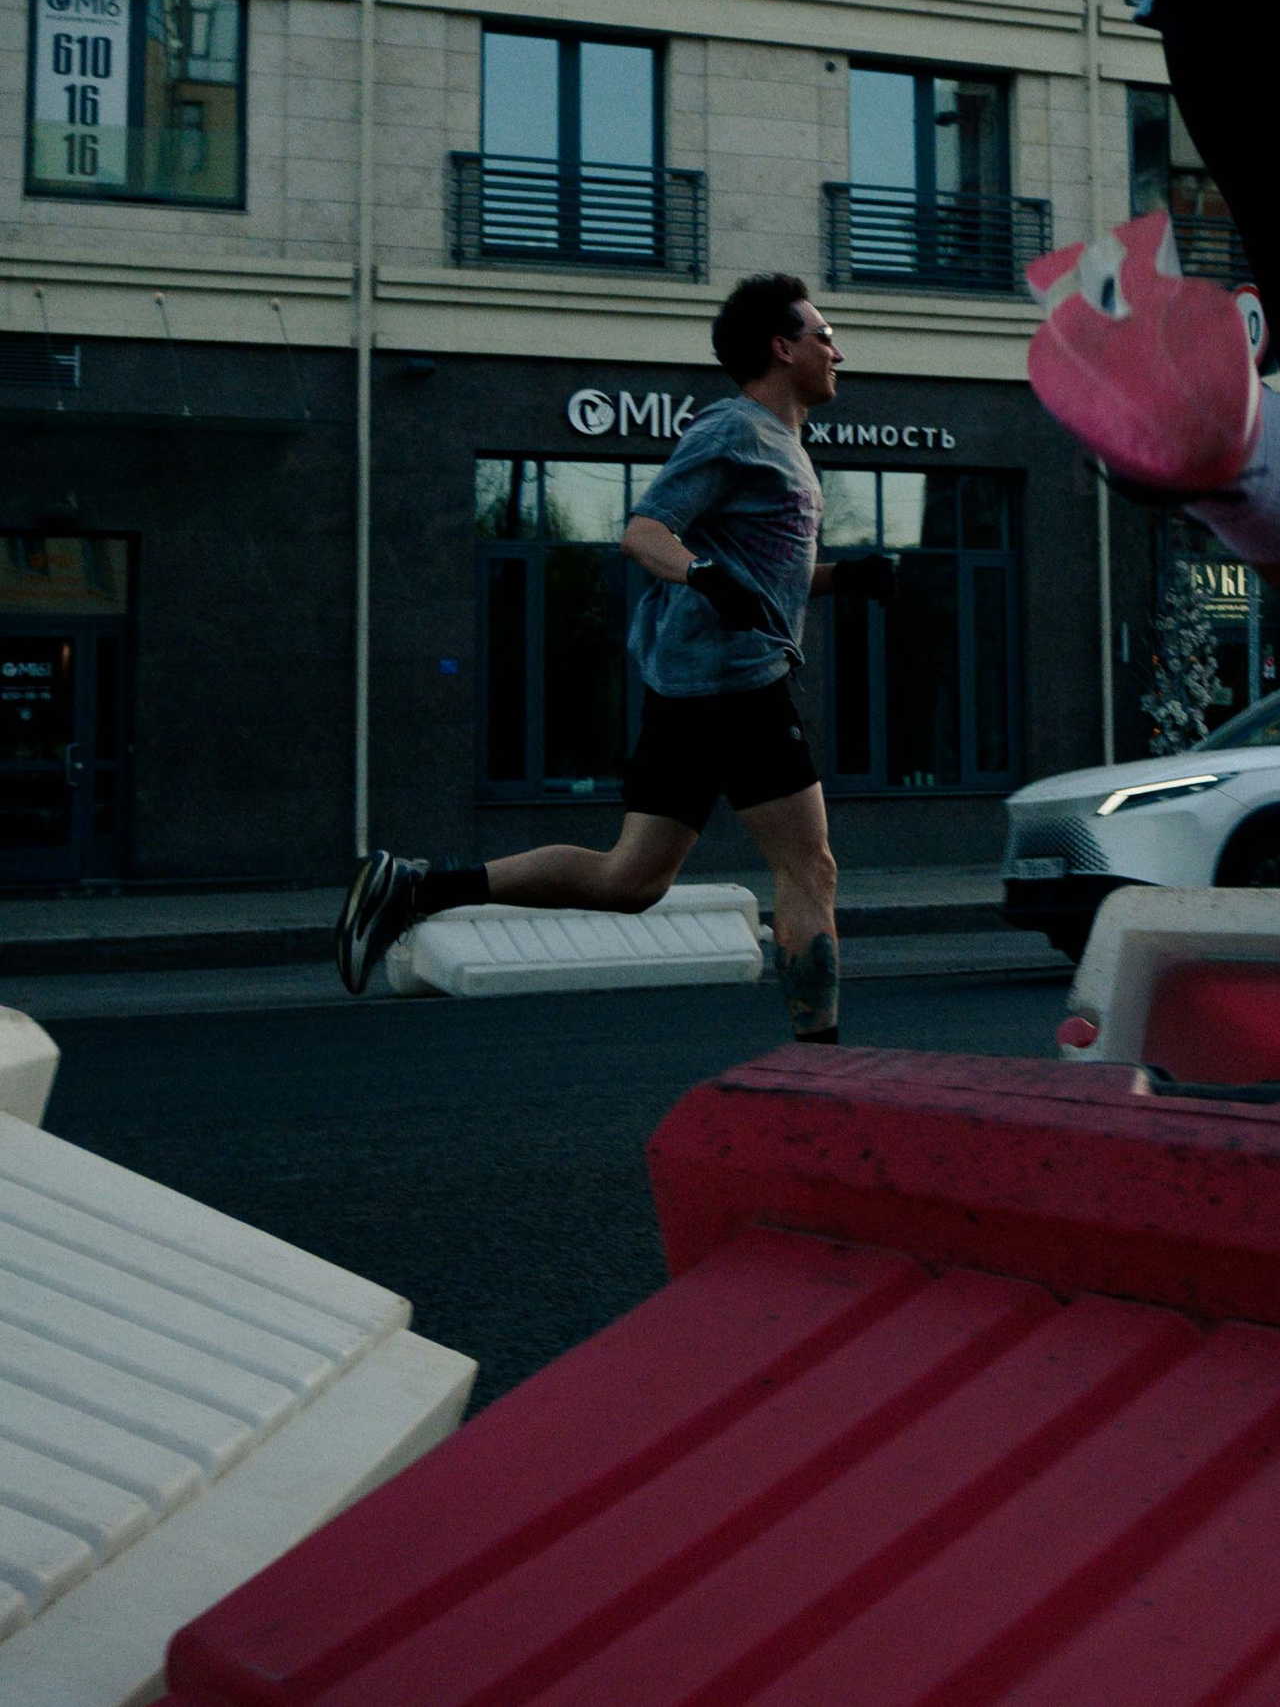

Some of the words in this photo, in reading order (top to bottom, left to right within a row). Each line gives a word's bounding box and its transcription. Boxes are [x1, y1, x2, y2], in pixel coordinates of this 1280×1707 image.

[53, 32, 113, 79] 610
[63, 84, 99, 127] 16
[63, 132, 99, 176] 16
[1248, 310, 1261, 346] 0
[807, 421, 956, 449] ЖИМОСТЬ
